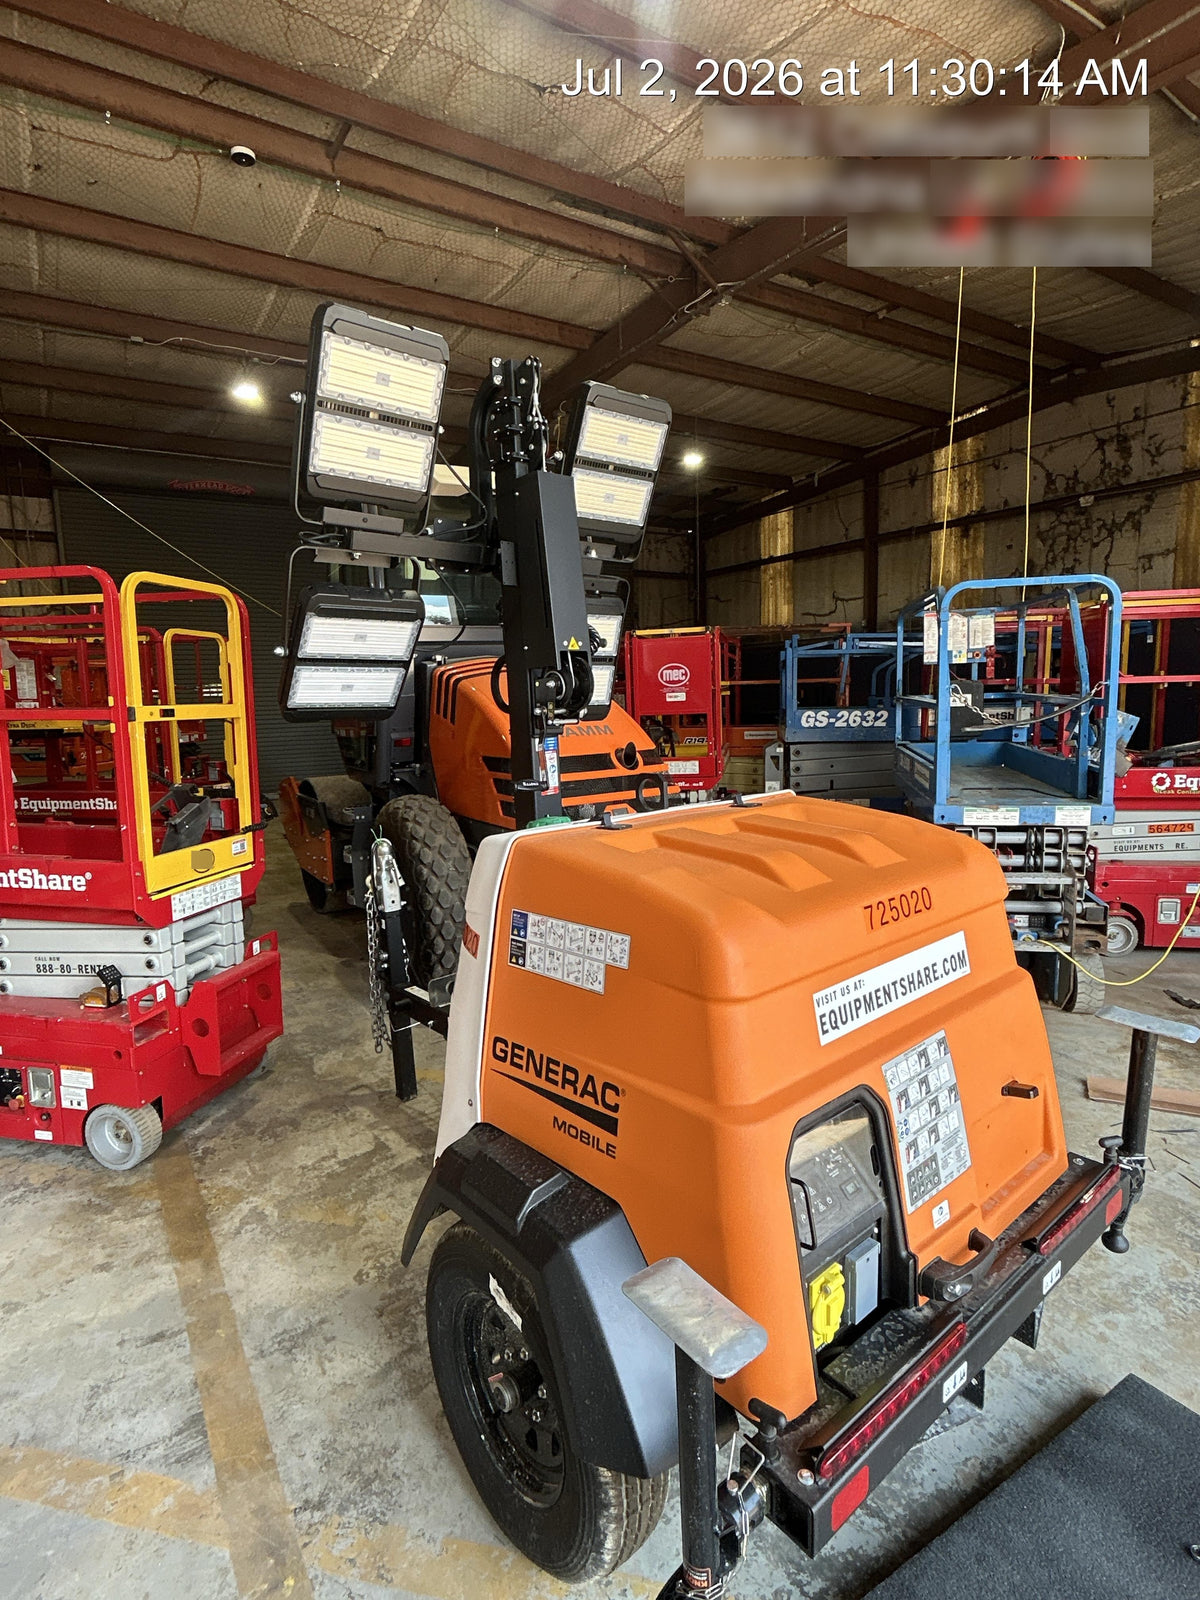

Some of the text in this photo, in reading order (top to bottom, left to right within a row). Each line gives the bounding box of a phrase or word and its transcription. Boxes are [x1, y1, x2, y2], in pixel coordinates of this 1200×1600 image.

[800, 710, 889, 728] GS-2632
[562, 725, 614, 737] AMM
[1148, 823, 1194, 834] 564729
[864, 886, 933, 930] 725020
[36, 963, 107, 975] 888-80-RENT
[815, 979, 865, 1008] VISIT US AT:
[818, 950, 968, 1036] EQUIPMENTSHARE.COM
[553, 1115, 616, 1160] MOBILE
